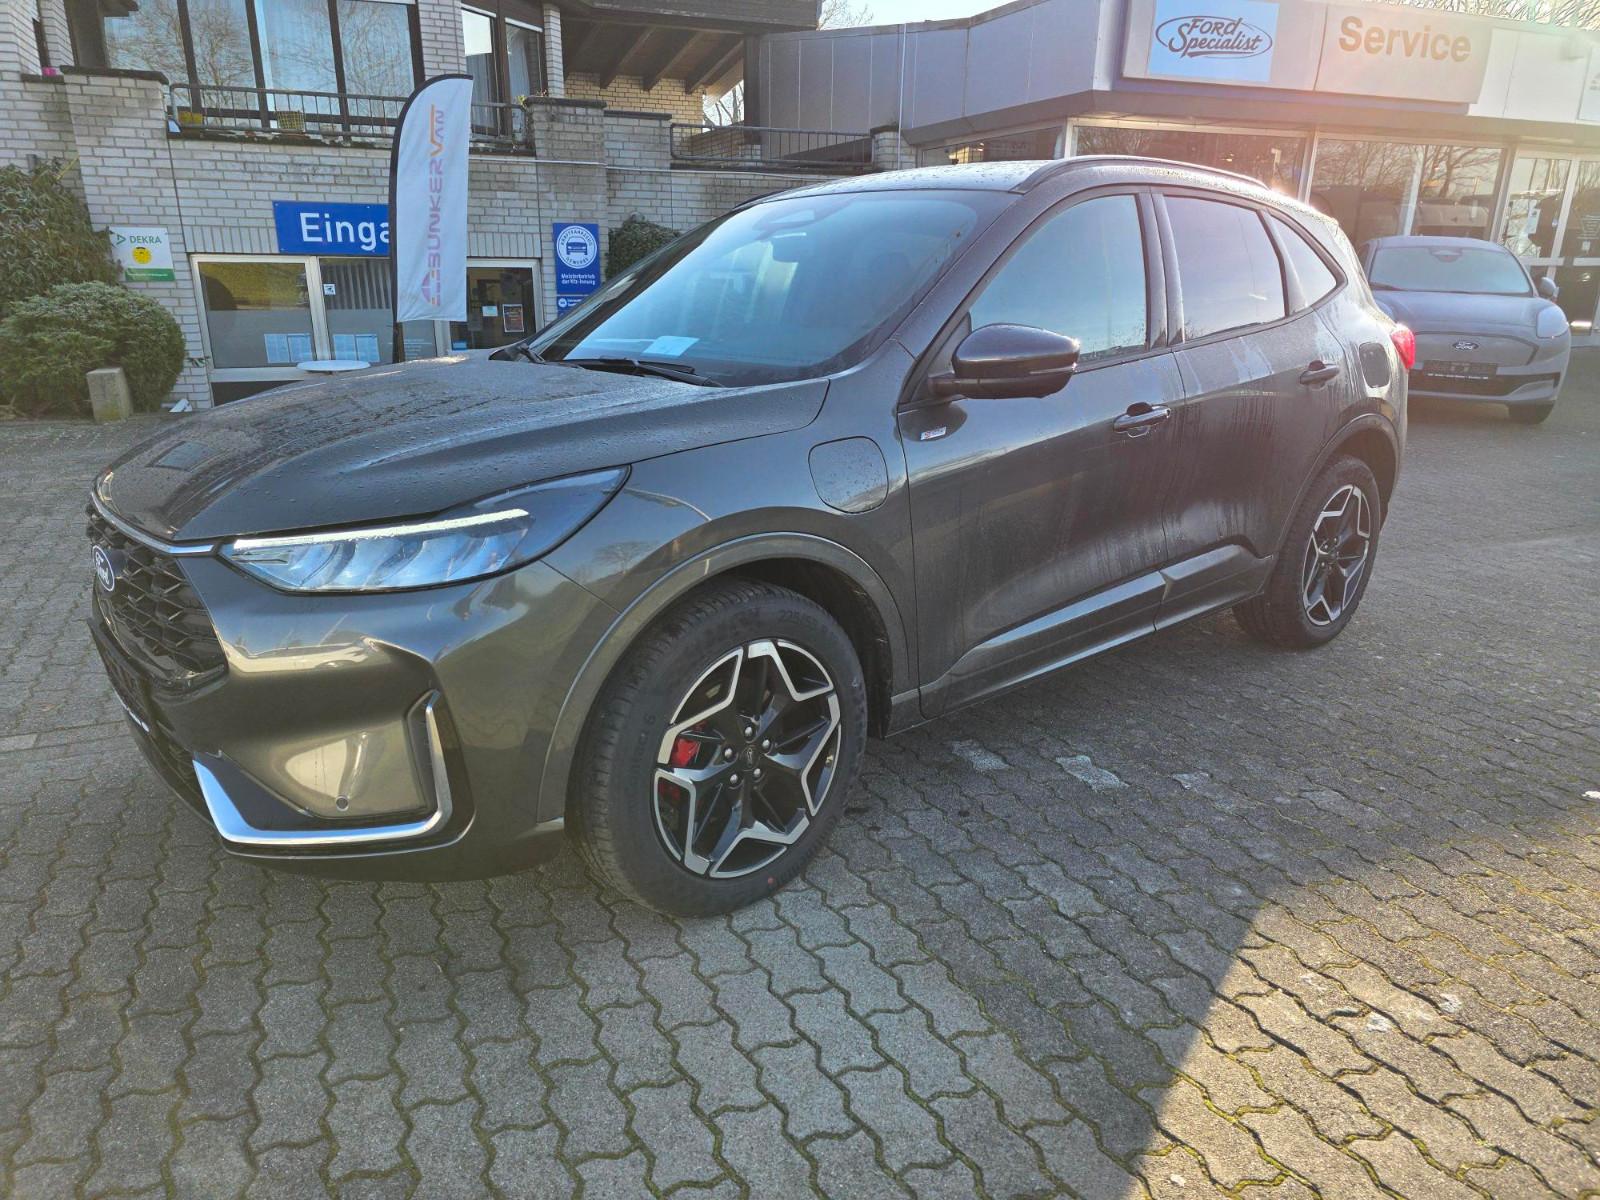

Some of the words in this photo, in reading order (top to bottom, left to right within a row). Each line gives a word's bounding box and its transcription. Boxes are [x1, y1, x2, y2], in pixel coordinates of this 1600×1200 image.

[1168, 23, 1262, 58] Specialist
[1339, 16, 1472, 62] Service
[129, 235, 162, 244] DEKRA
